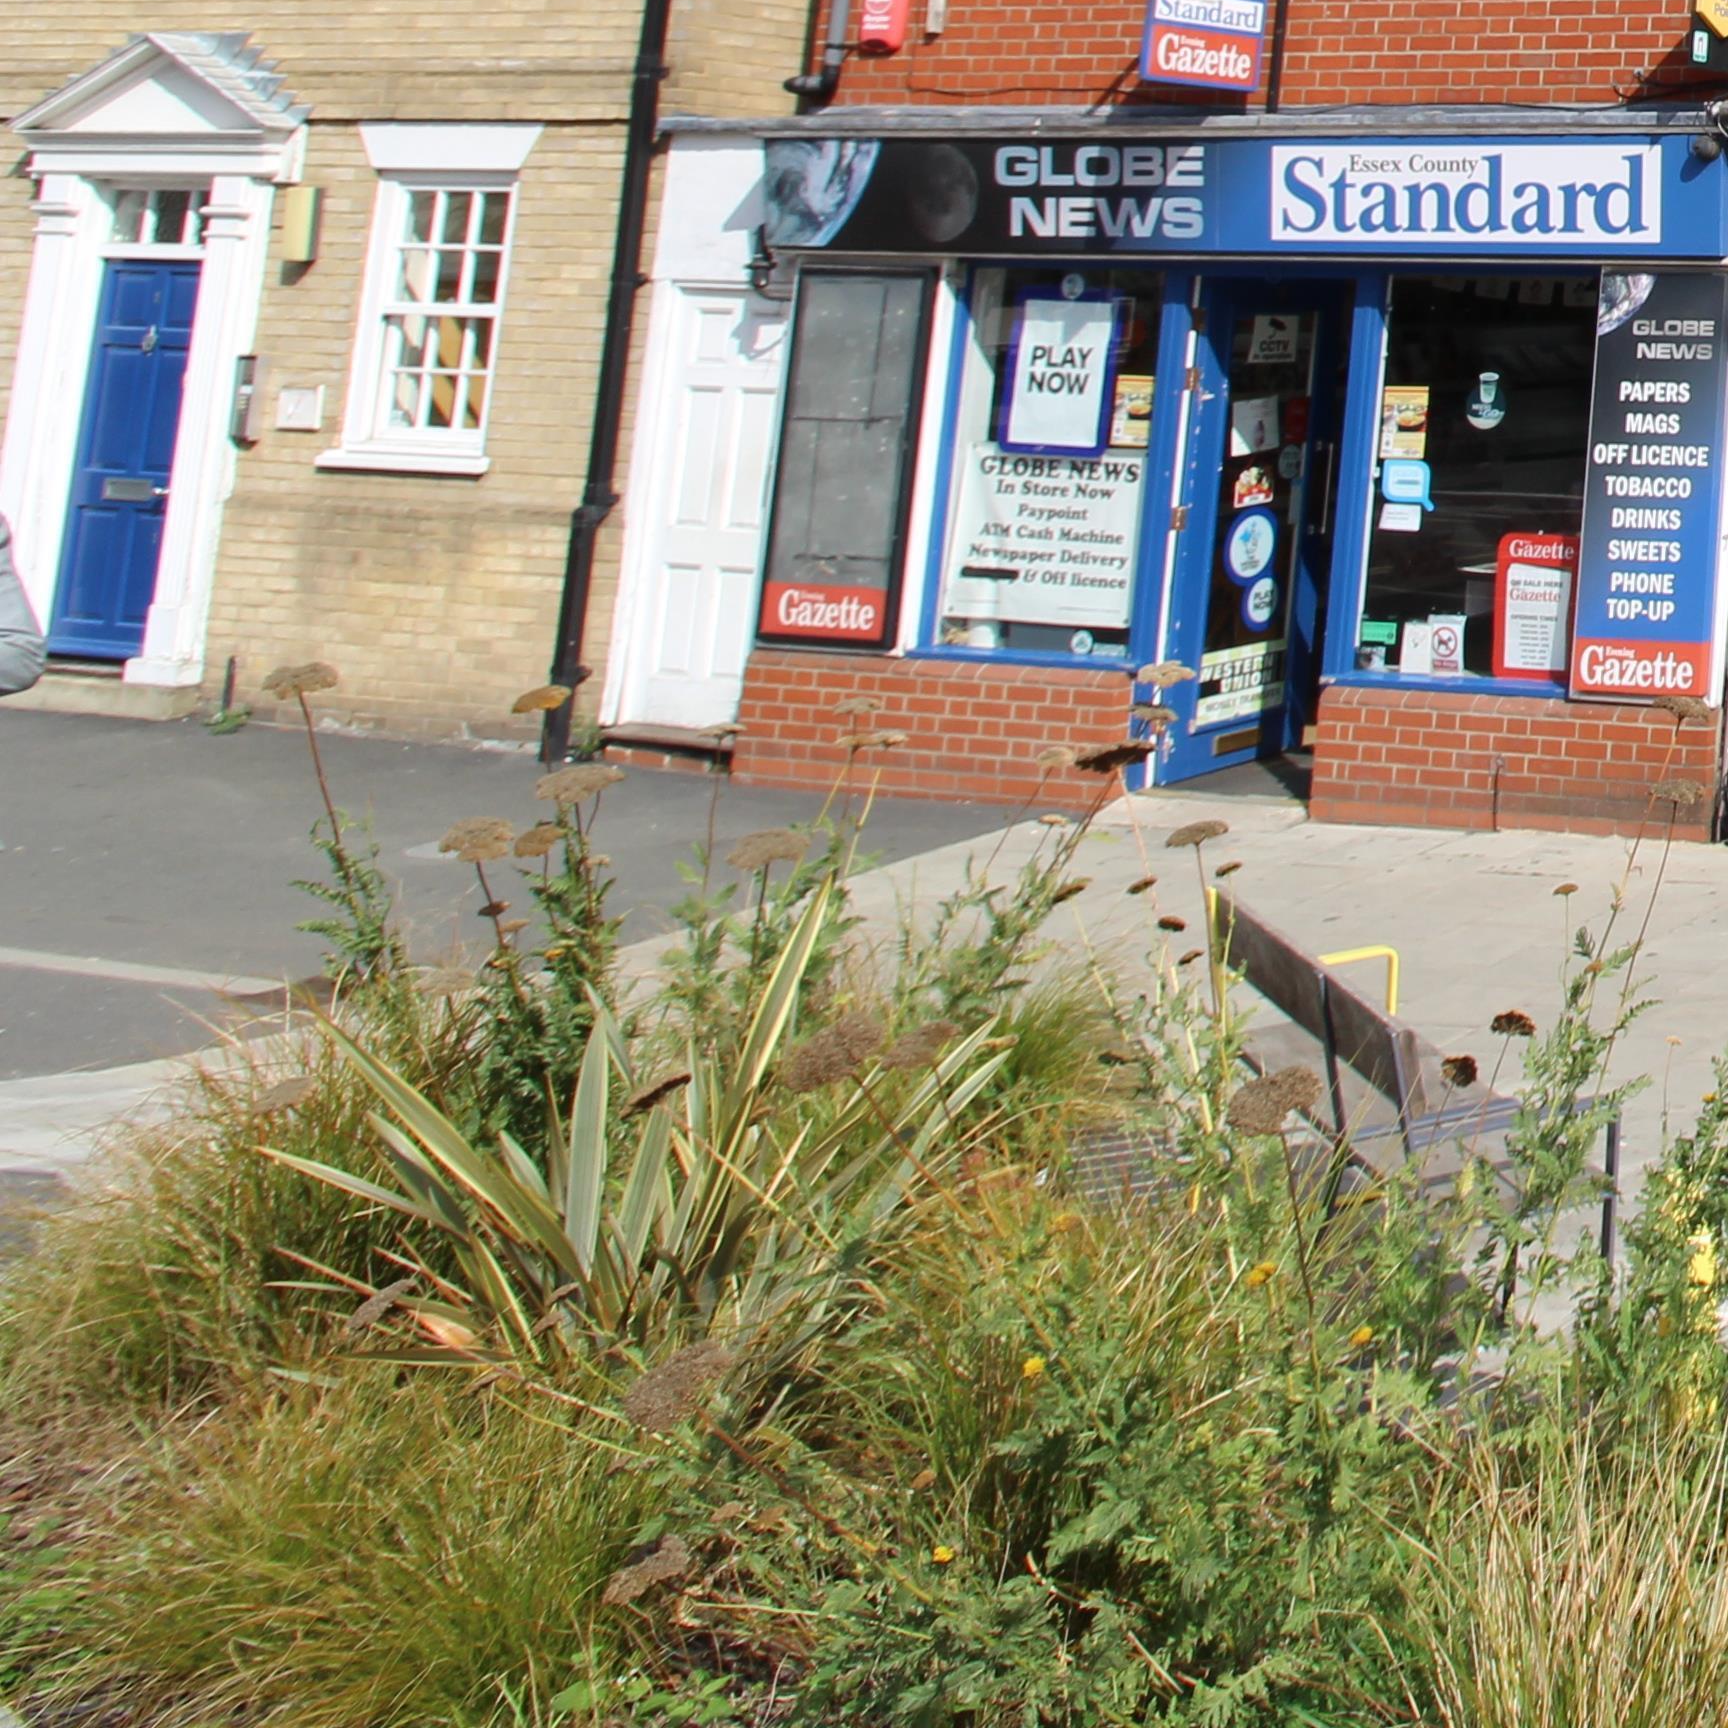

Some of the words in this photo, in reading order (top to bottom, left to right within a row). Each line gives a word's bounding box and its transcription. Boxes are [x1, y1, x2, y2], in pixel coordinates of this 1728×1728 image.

[1157, 32, 1251, 79] Gazette
[994, 145, 1205, 187] GLOBE
[1349, 153, 1402, 173] Essex
[1408, 153, 1479, 179] County
[1281, 152, 1650, 235] Standard
[1009, 196, 1205, 239] NEWS
[1632, 319, 1715, 337] GLOBE
[1030, 345, 1094, 369] PLAY
[1259, 340, 1290, 352] CCTV
[1636, 343, 1713, 360] NEWS
[1026, 371, 1090, 395] NOW
[1618, 381, 1691, 404] PAPERS
[1624, 413, 1681, 434] MAGS
[1593, 443, 1629, 465] OFF
[1631, 445, 1710, 467] LICENCE
[980, 455, 1060, 478] GLOBE
[1068, 461, 1140, 484] NEWS
[995, 479, 1014, 494] In
[1020, 480, 1070, 498] Store
[1074, 483, 1116, 500] Now
[1605, 475, 1692, 498] TOBACCO
[1016, 503, 1089, 521] Paypoint
[1611, 507, 1682, 530] DRINKS
[979, 522, 1012, 537] ATM
[1016, 525, 1054, 541] Cash
[1058, 526, 1124, 545] Machine
[968, 544, 1056, 564] Newspaper
[1059, 550, 1129, 570] Delivery
[1509, 539, 1575, 560] Gazette
[1607, 539, 1681, 562] SWEETS
[1023, 569, 1037, 584] &
[1041, 570, 1067, 585] Off
[1071, 572, 1127, 589] licence
[1523, 579, 1541, 587] SALE
[1610, 572, 1676, 594] PHONE
[1509, 587, 1561, 603] Gazette
[778, 588, 875, 631] Gazette
[1606, 598, 1676, 621] TOP-UP
[1605, 646, 1636, 659] Evening
[1199, 653, 1275, 683] WESTERN
[1579, 644, 1694, 690] Gazette
[1220, 669, 1273, 693] UNION
